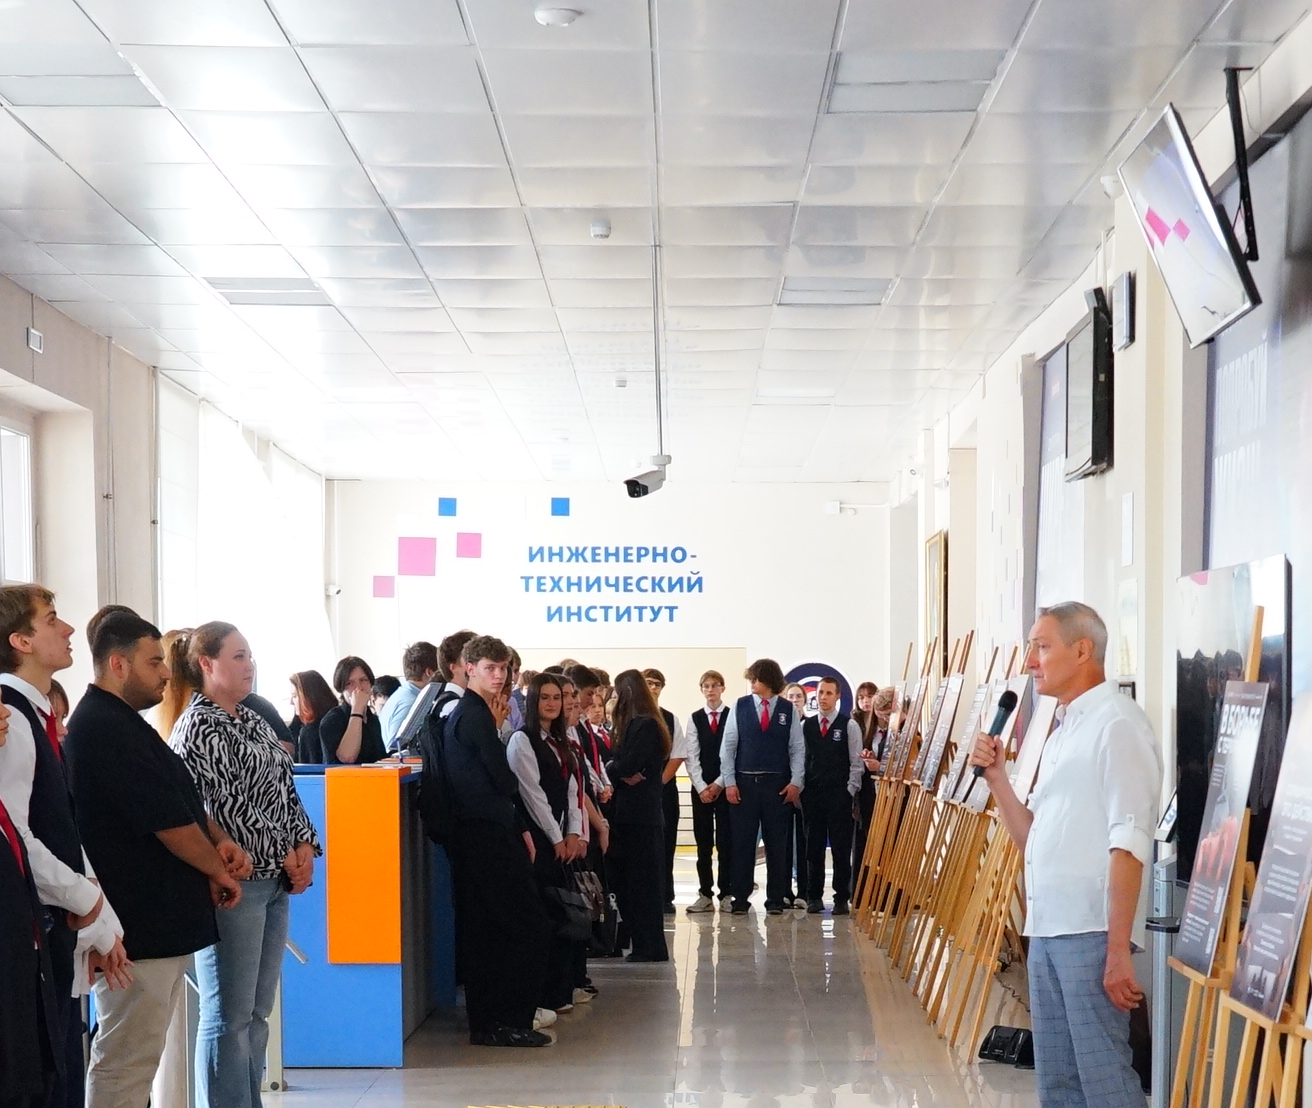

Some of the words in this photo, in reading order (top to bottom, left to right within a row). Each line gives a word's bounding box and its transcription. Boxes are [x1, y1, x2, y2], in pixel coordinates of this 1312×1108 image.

[528, 546, 697, 563] ИНЖЕНЕРНО-
[520, 570, 703, 593] ТЕХНИЧЕСКИЙ
[546, 605, 679, 623] ИНСТИТУТ
